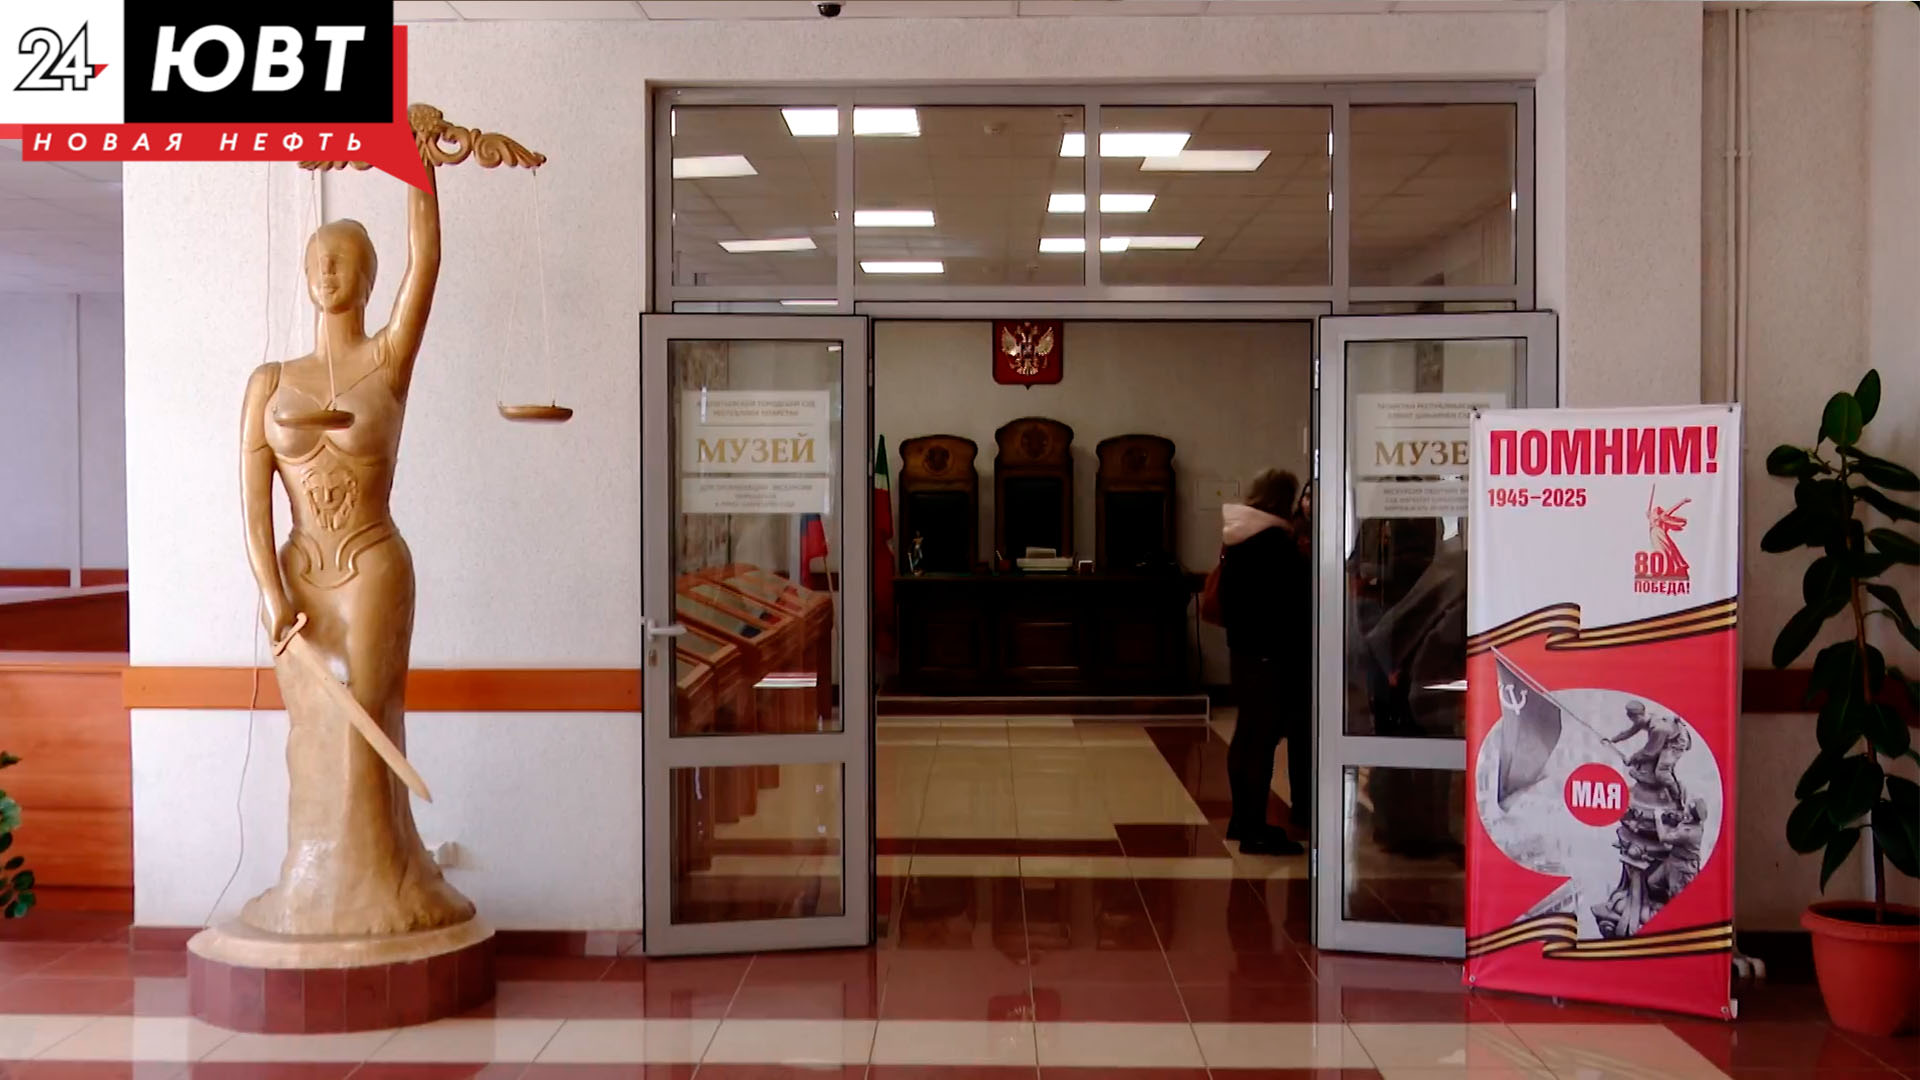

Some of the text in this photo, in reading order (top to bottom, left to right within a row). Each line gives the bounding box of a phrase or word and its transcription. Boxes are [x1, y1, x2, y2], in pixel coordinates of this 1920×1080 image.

[696, 432, 816, 464] МУЗЕЙ
[1375, 441, 1470, 466] МУЗЕ
[1489, 426, 1719, 477] ПОМНИМ!
[1634, 551, 1665, 577] 80
[1634, 581, 1690, 596] ПОБЕДА!
[1571, 780, 1621, 810] МАЯ
